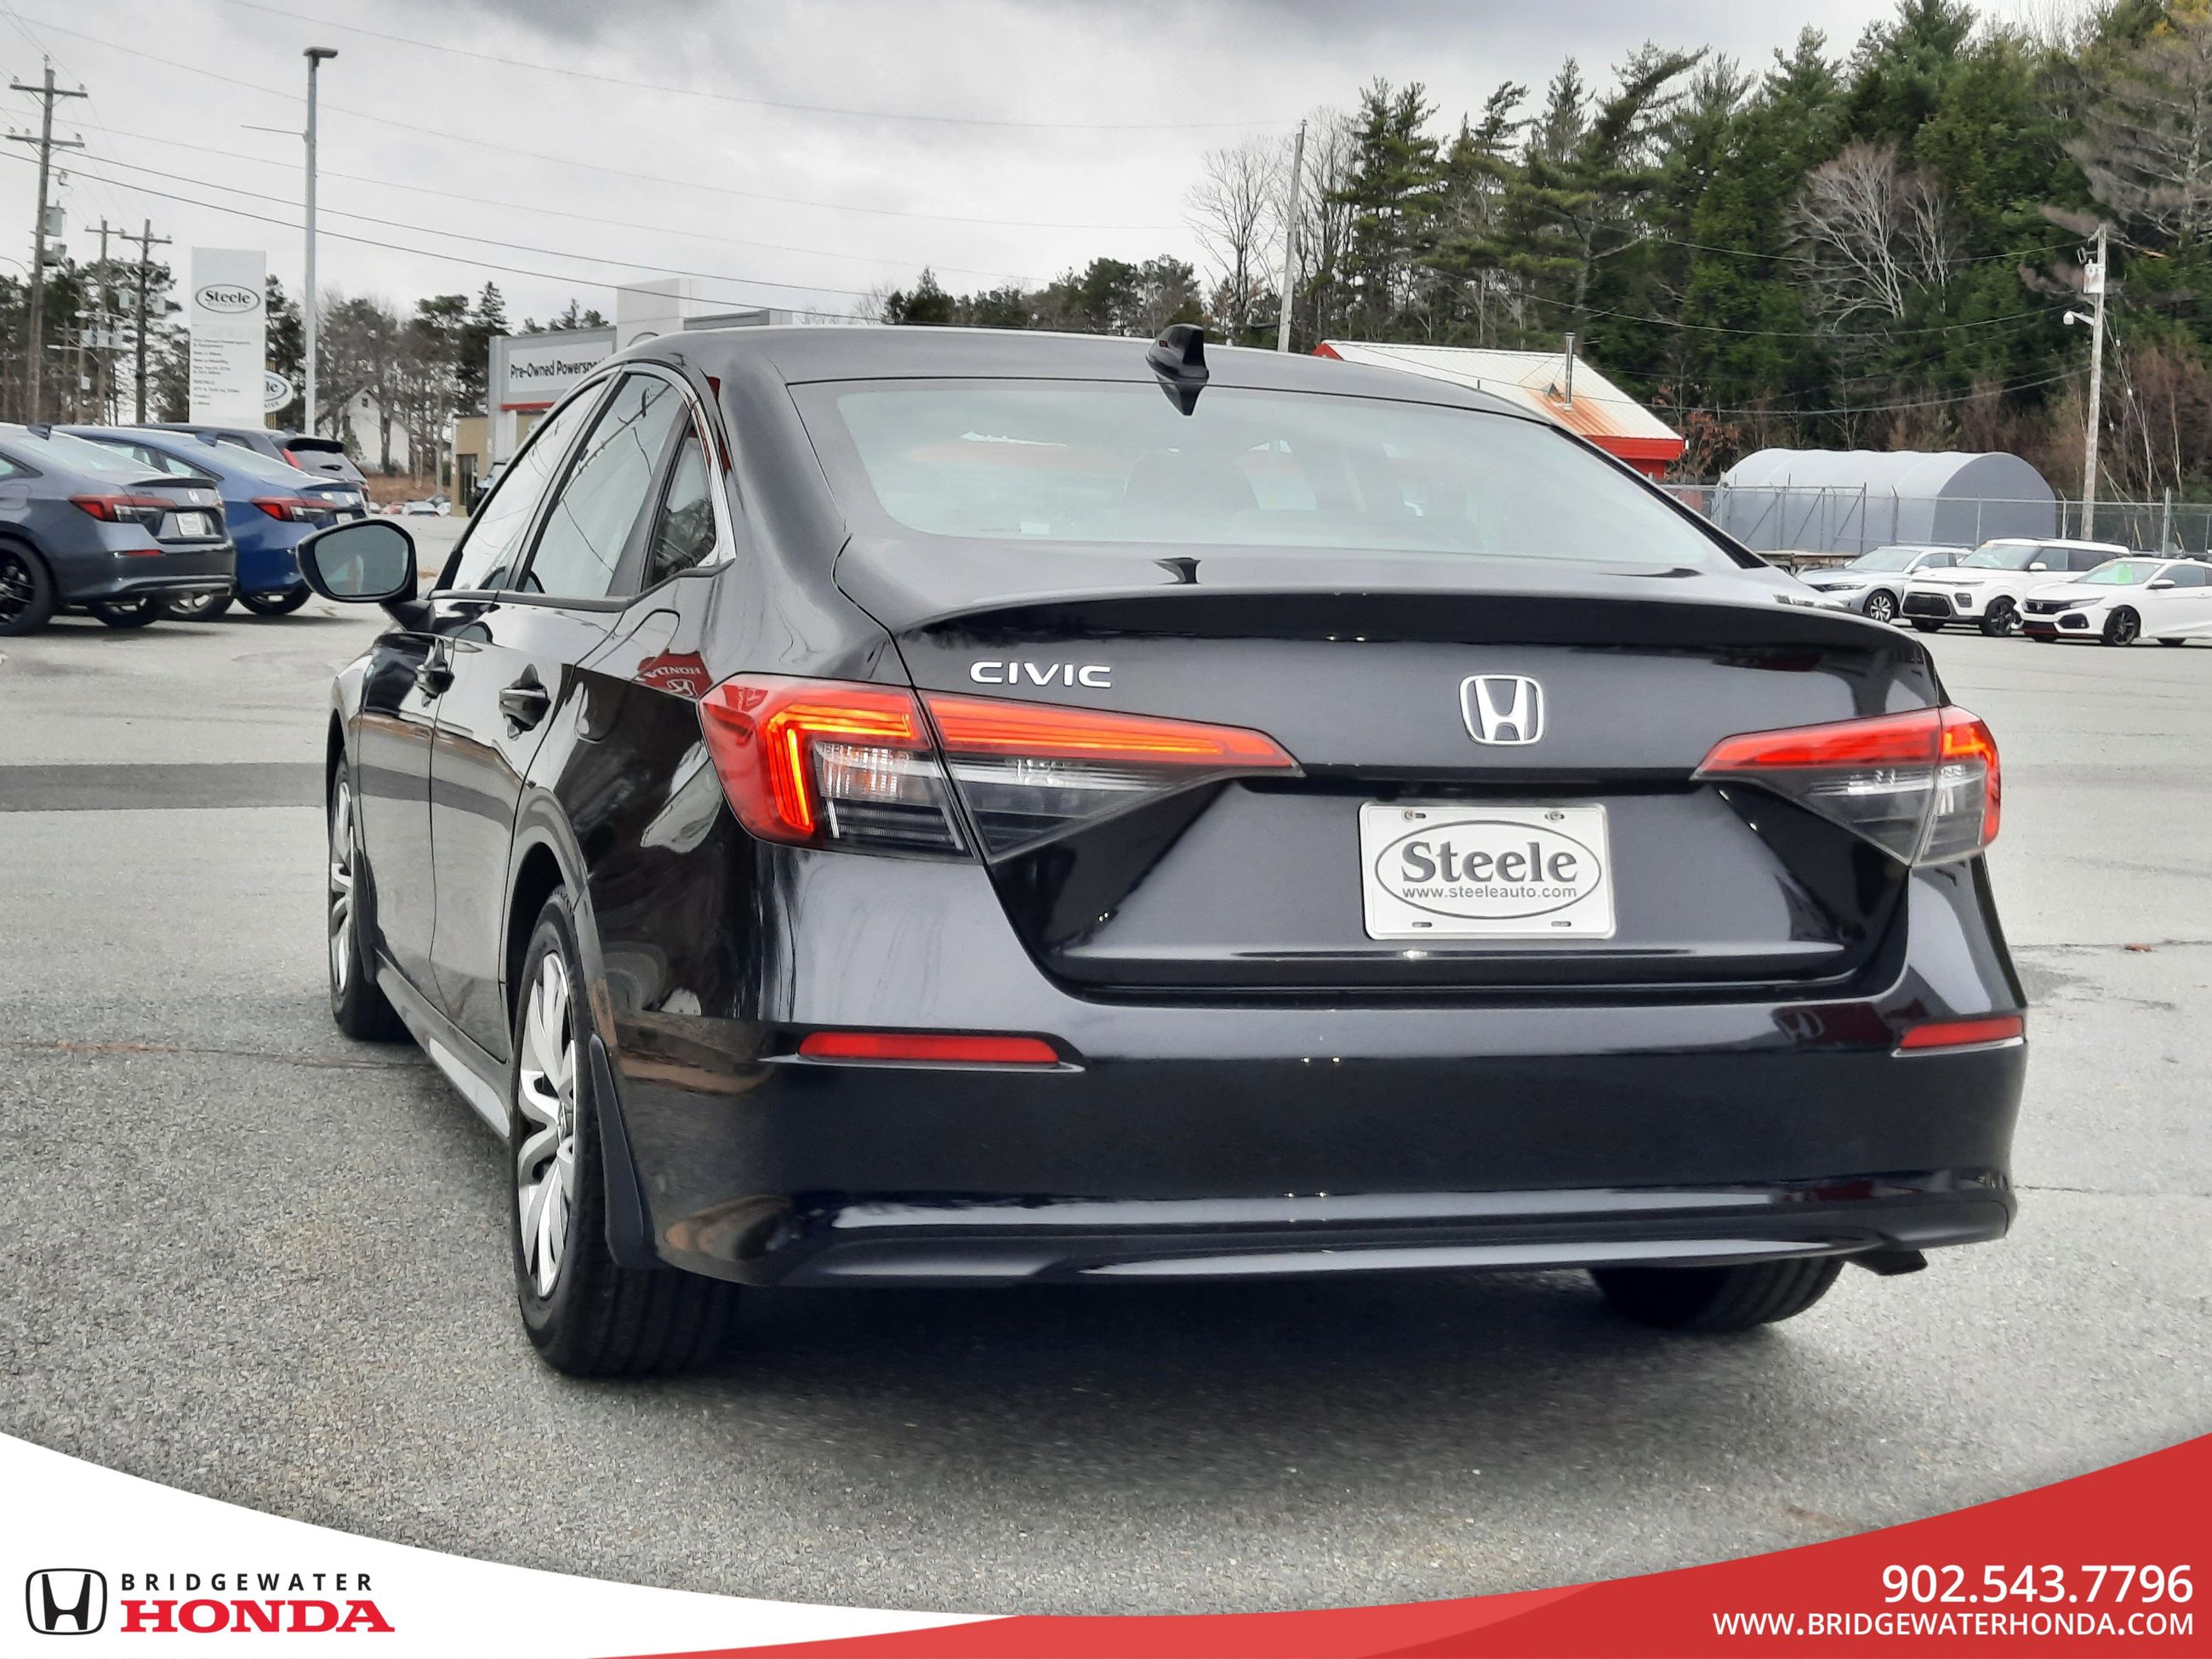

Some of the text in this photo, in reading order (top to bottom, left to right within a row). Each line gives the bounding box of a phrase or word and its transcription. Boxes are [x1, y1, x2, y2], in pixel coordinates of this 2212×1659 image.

[204, 290, 251, 303] Steele
[510, 357, 605, 379] Pre-Owned Powersp
[970, 661, 1112, 688] CIVIC
[1400, 841, 1578, 883] Steele
[1401, 884, 1578, 899] www.steeleauto.com
